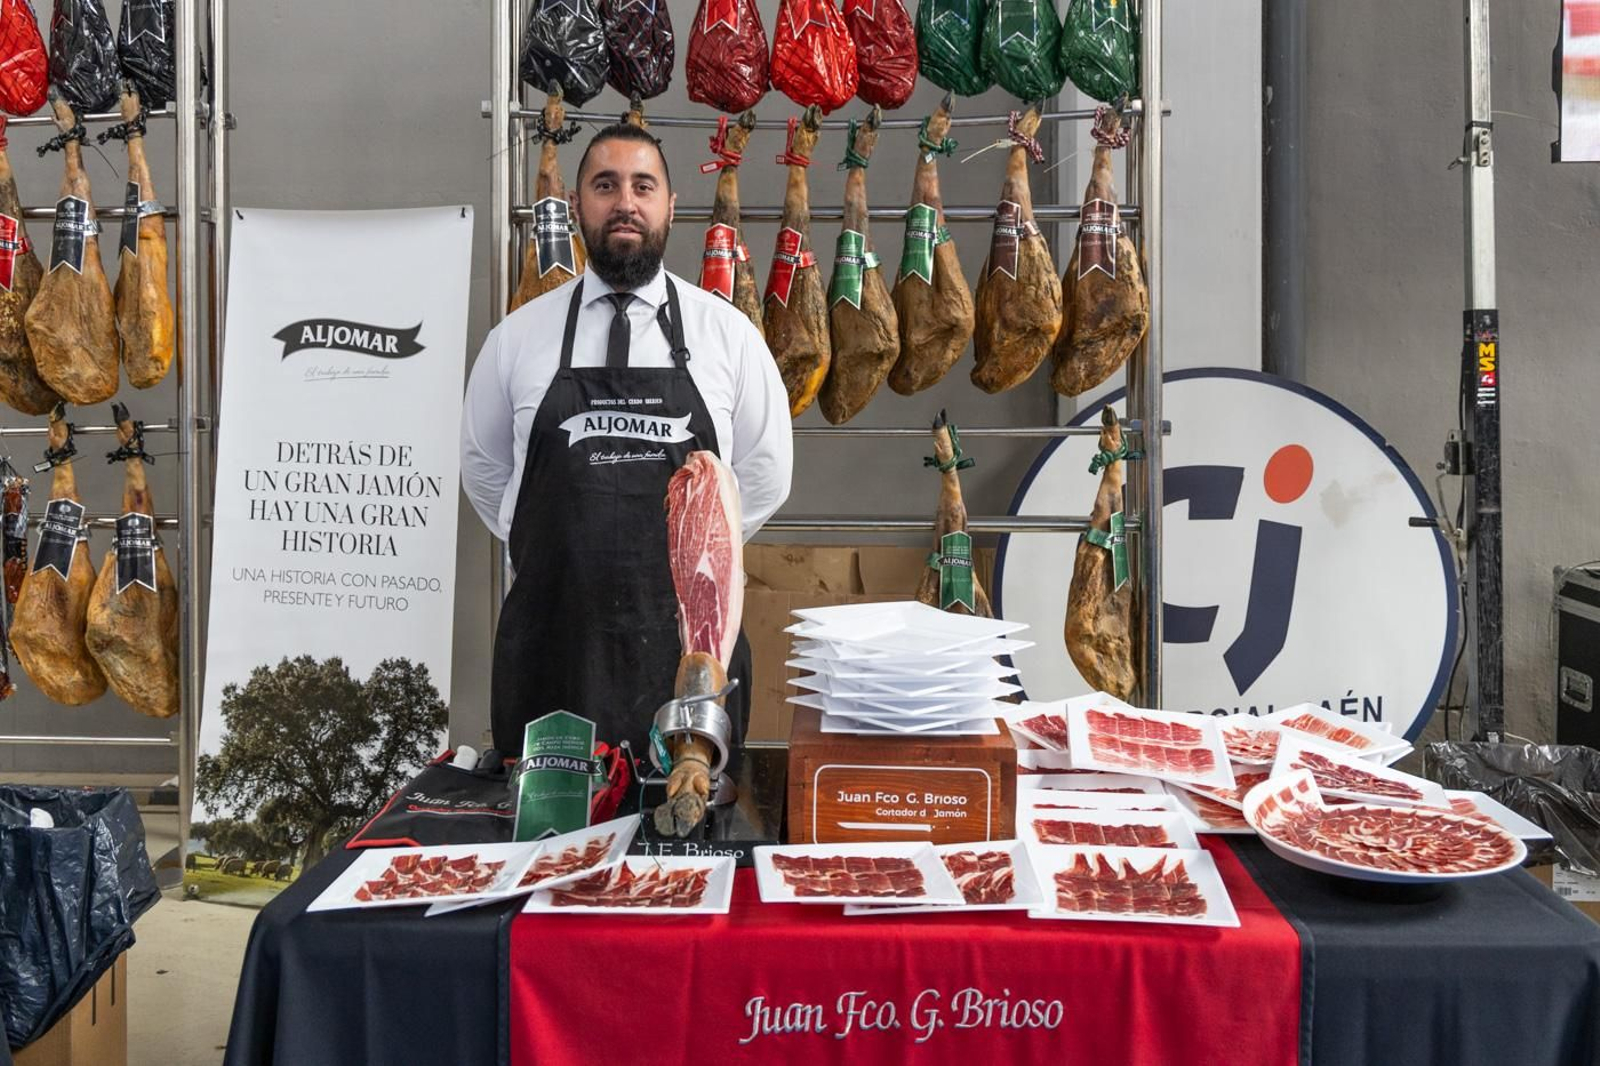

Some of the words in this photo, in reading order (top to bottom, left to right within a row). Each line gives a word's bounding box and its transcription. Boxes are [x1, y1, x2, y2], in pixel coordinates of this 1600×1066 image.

[300, 325, 399, 353] ALJOMAR
[584, 416, 672, 437] ALJOMAR
[276, 441, 372, 466] DETRÁS
[379, 444, 412, 467] DE
[244, 469, 279, 491] UN
[285, 470, 352, 494] GRAN
[356, 471, 442, 498] JAMÓN
[249, 499, 299, 522] HAY
[304, 501, 355, 525] UNA
[361, 503, 429, 528] GRAN
[281, 530, 398, 557] HISTORIA
[232, 567, 266, 583] UNA
[271, 569, 336, 586] HISTORIA
[341, 572, 376, 588] CON
[381, 575, 443, 593] PASADO,
[263, 589, 333, 608] PRESENTE
[333, 593, 345, 608] Y
[349, 593, 409, 612] FUTURO
[526, 757, 588, 772] ALJOMAR
[406, 792, 450, 806] Juan
[837, 791, 870, 803] Juan
[906, 793, 919, 805] G.
[924, 793, 968, 805] Brioso
[875, 807, 917, 818] Cortador
[933, 808, 967, 818] Jamón
[683, 842, 744, 859] Brioso
[738, 996, 827, 1045] Juan
[834, 990, 900, 1039] Fco.
[910, 988, 945, 1043] G.
[951, 987, 1063, 1029] Brioso
